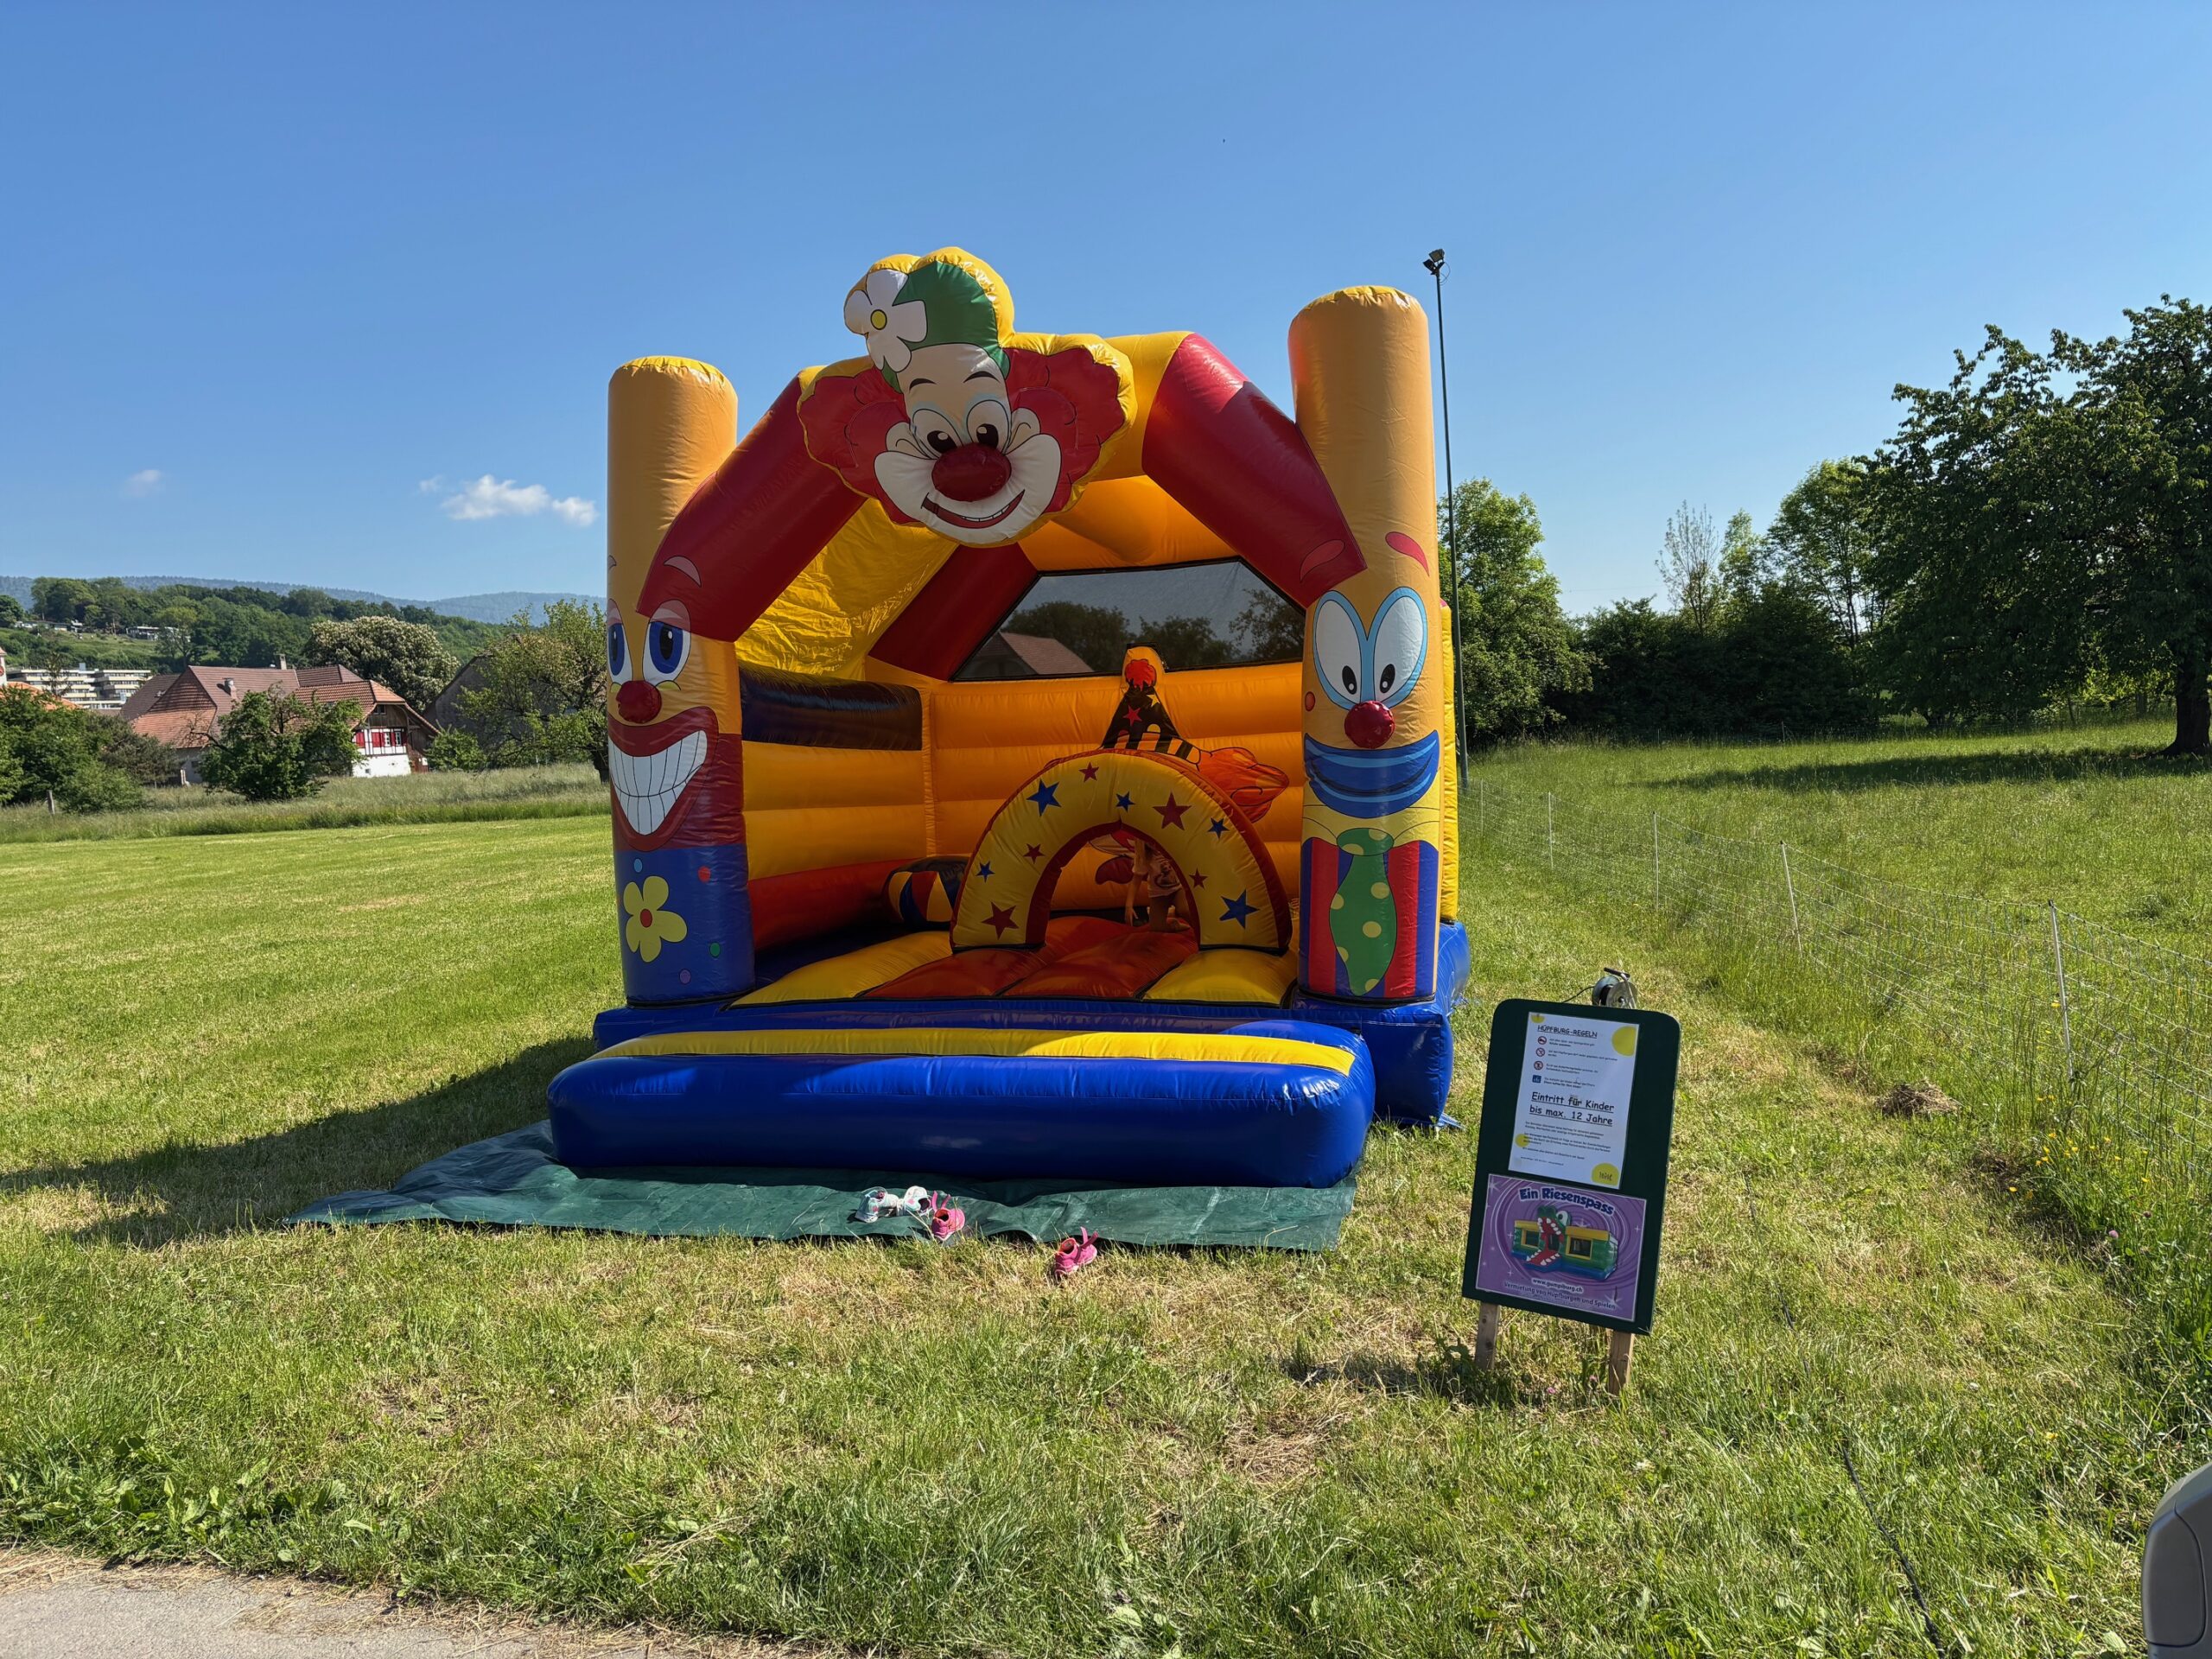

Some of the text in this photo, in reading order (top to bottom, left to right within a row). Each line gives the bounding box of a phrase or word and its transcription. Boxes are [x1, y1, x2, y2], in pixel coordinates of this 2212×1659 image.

[1537, 1025, 1598, 1038] HÜPFBURG-REGELN
[1532, 1091, 1614, 1111] Eintritt für Kinder
[1529, 1104, 1613, 1125] bis max. 12 Jahre
[1519, 1188, 1614, 1214] Ein Riesenspass
[1504, 1282, 1535, 1294] Vermietung
[1595, 1300, 1616, 1309] Spielen
